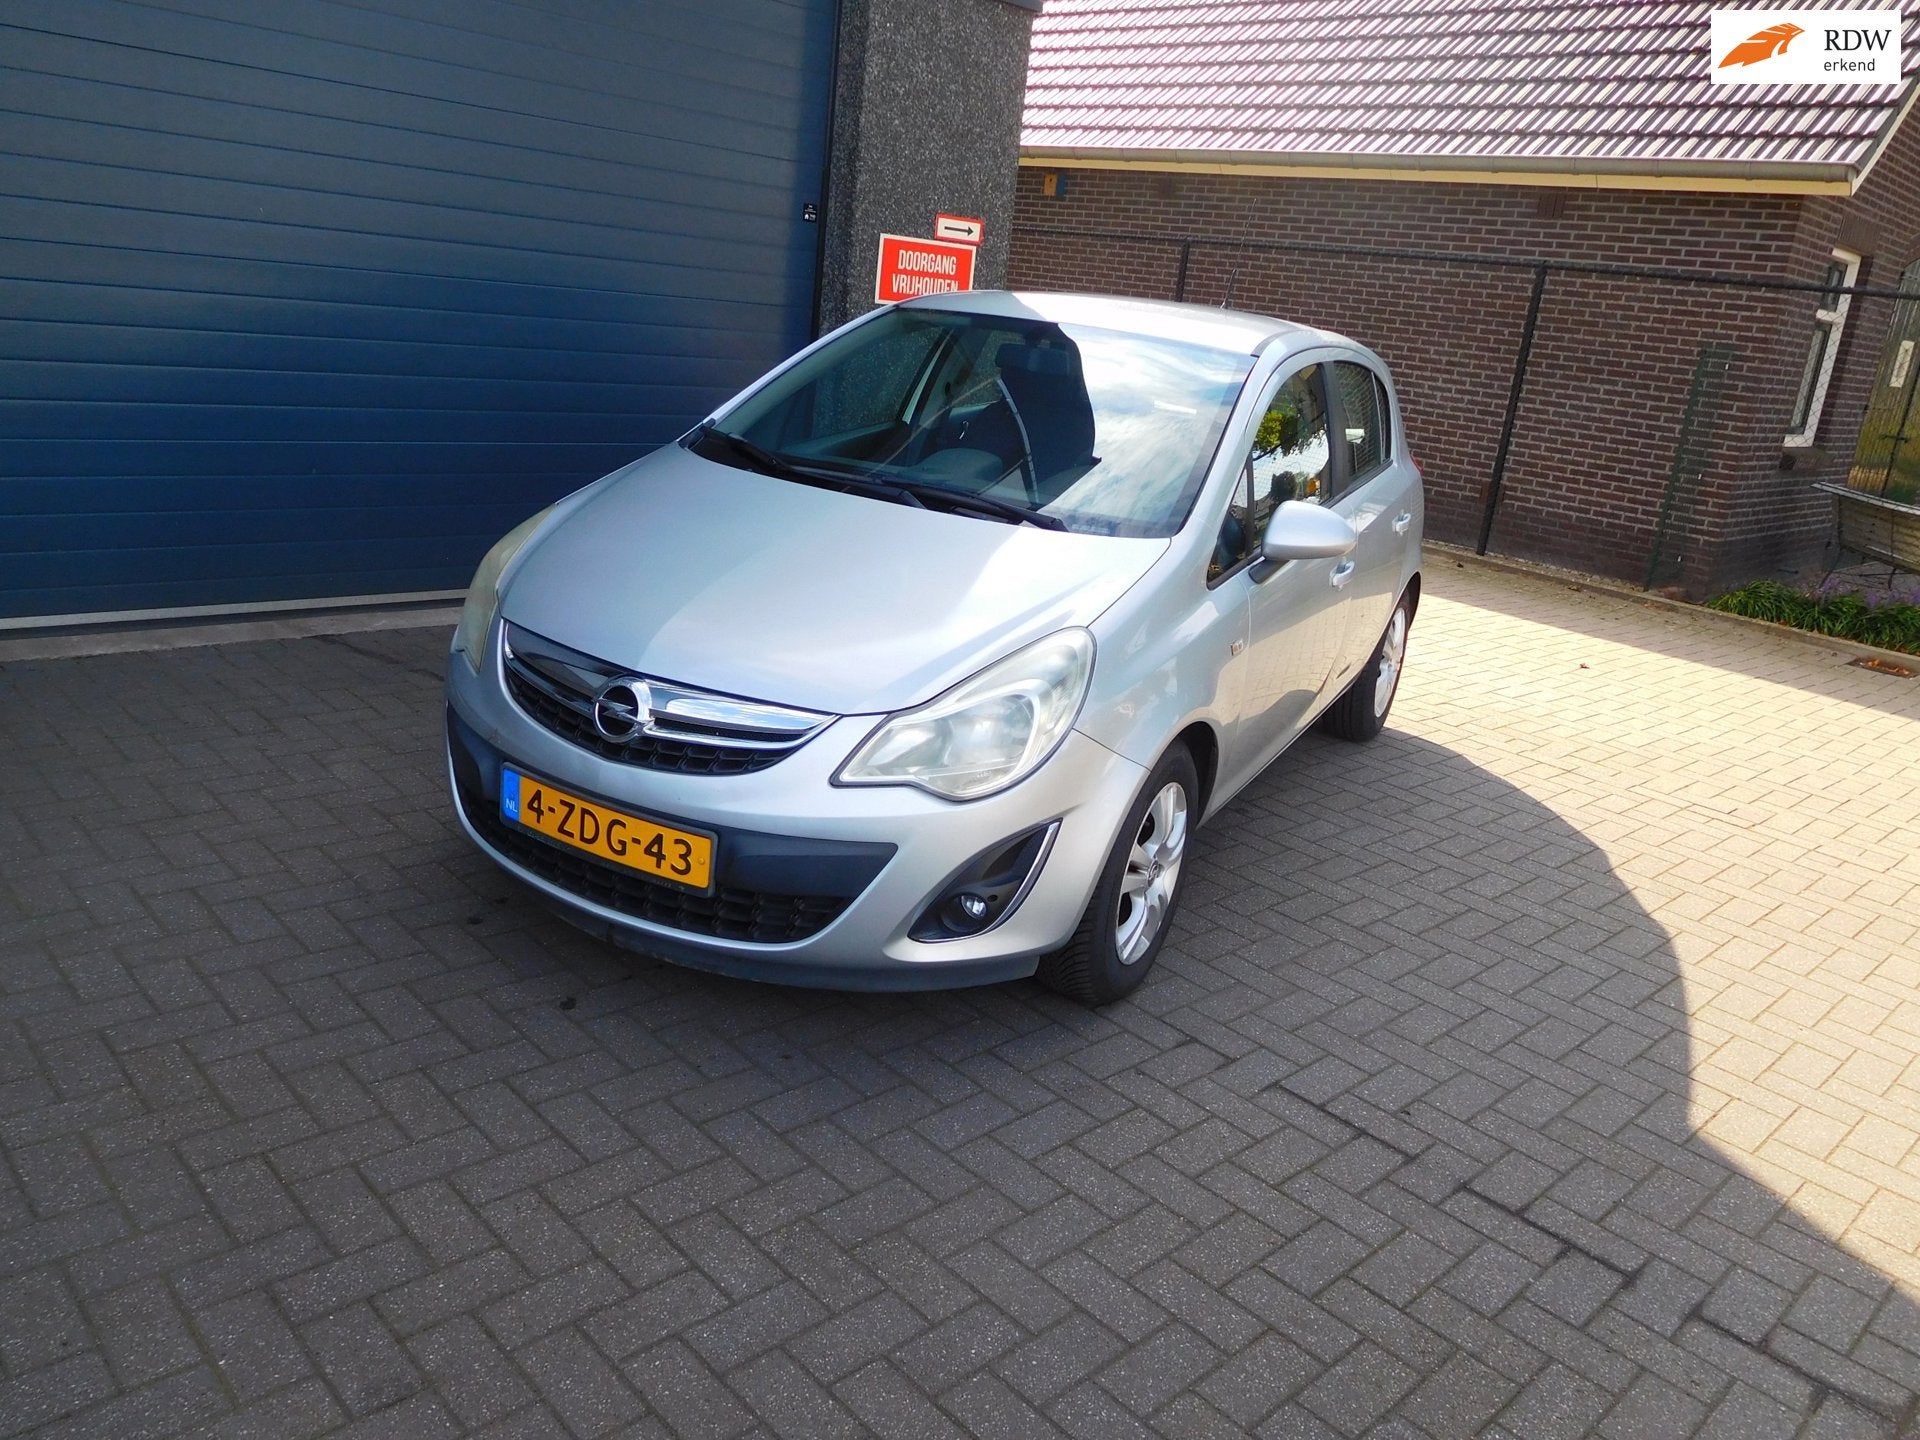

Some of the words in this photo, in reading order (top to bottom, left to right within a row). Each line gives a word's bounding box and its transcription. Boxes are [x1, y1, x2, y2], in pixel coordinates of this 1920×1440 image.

[897, 249, 957, 276] DOORGANG
[892, 273, 959, 296] VRIJHOUDEN
[505, 798, 518, 813] NL
[527, 789, 692, 875] 4-ZDG-43
